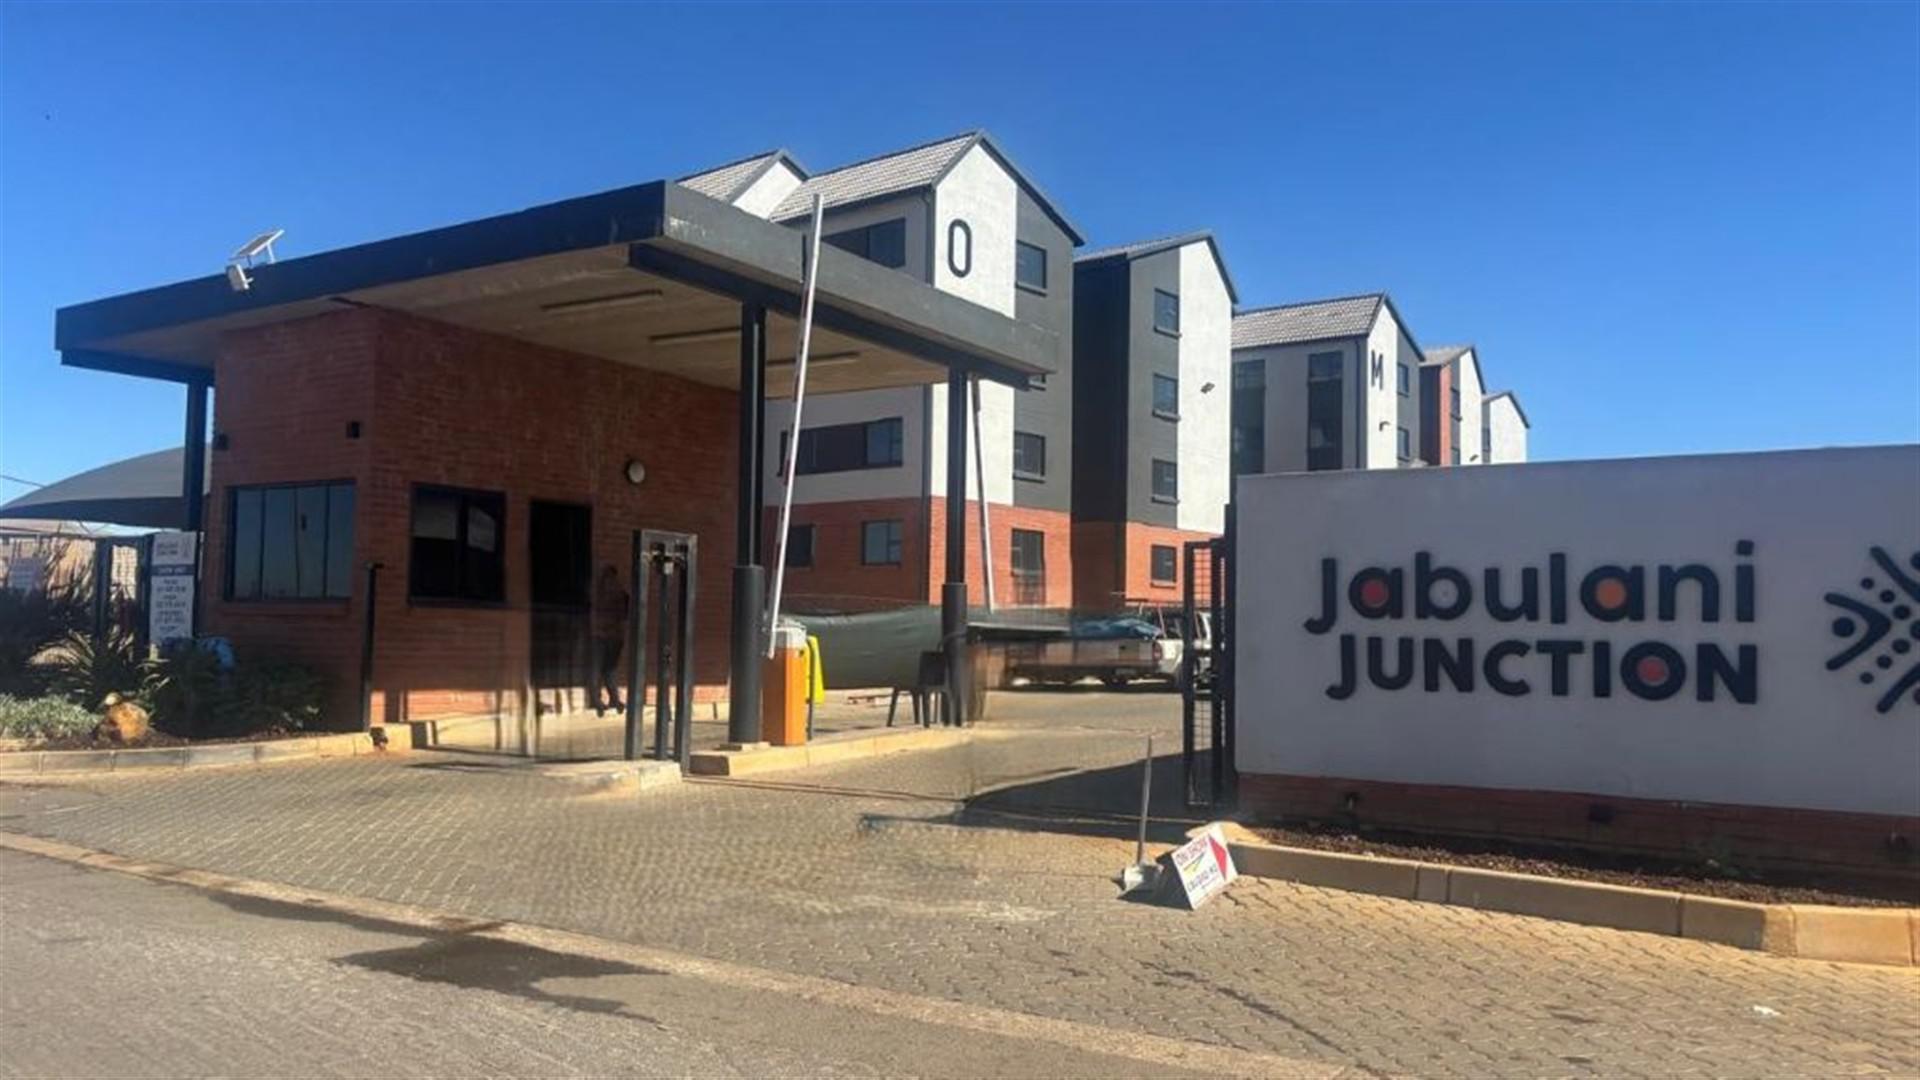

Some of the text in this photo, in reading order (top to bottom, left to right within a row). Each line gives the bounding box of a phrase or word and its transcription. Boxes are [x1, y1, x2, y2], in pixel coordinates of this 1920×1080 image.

[1371, 349, 1384, 391] M
[1304, 540, 1755, 635] Jabulani
[1325, 633, 1757, 704] JUNCTION
